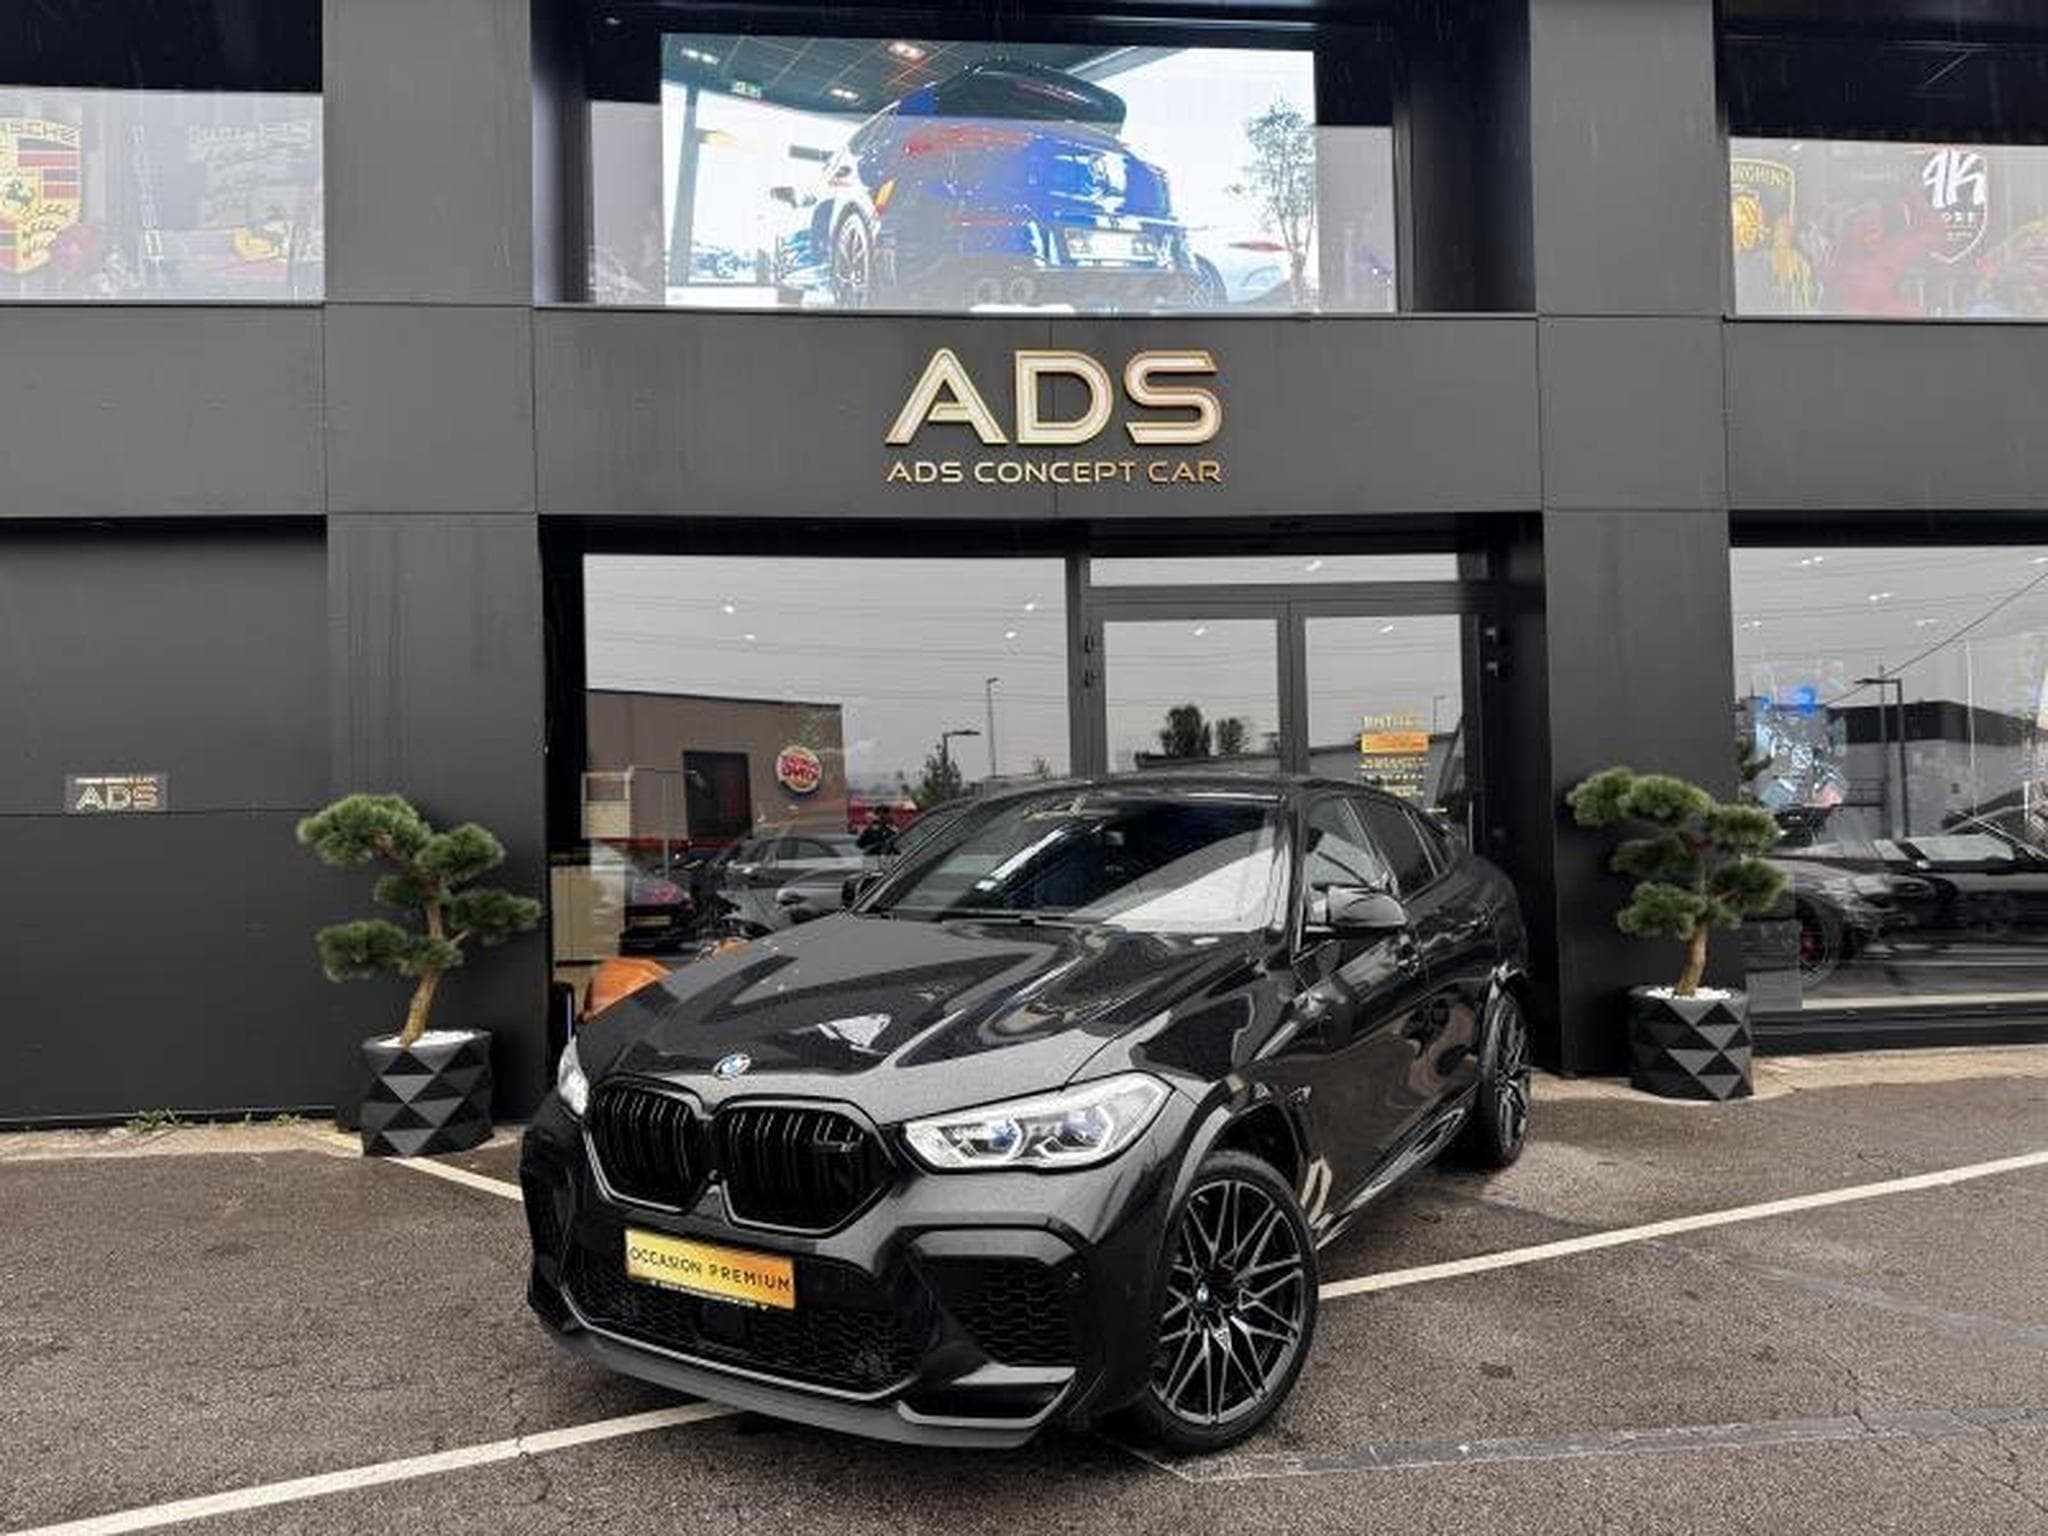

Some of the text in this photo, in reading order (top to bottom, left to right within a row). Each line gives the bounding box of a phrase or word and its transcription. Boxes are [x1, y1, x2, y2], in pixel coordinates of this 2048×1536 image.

[885, 347, 1223, 445] ADS
[887, 460, 1222, 483] ADS CONCEPT CAR
[75, 785, 158, 811] ADS
[630, 1246, 791, 1292] OCCASION PREMIUM
